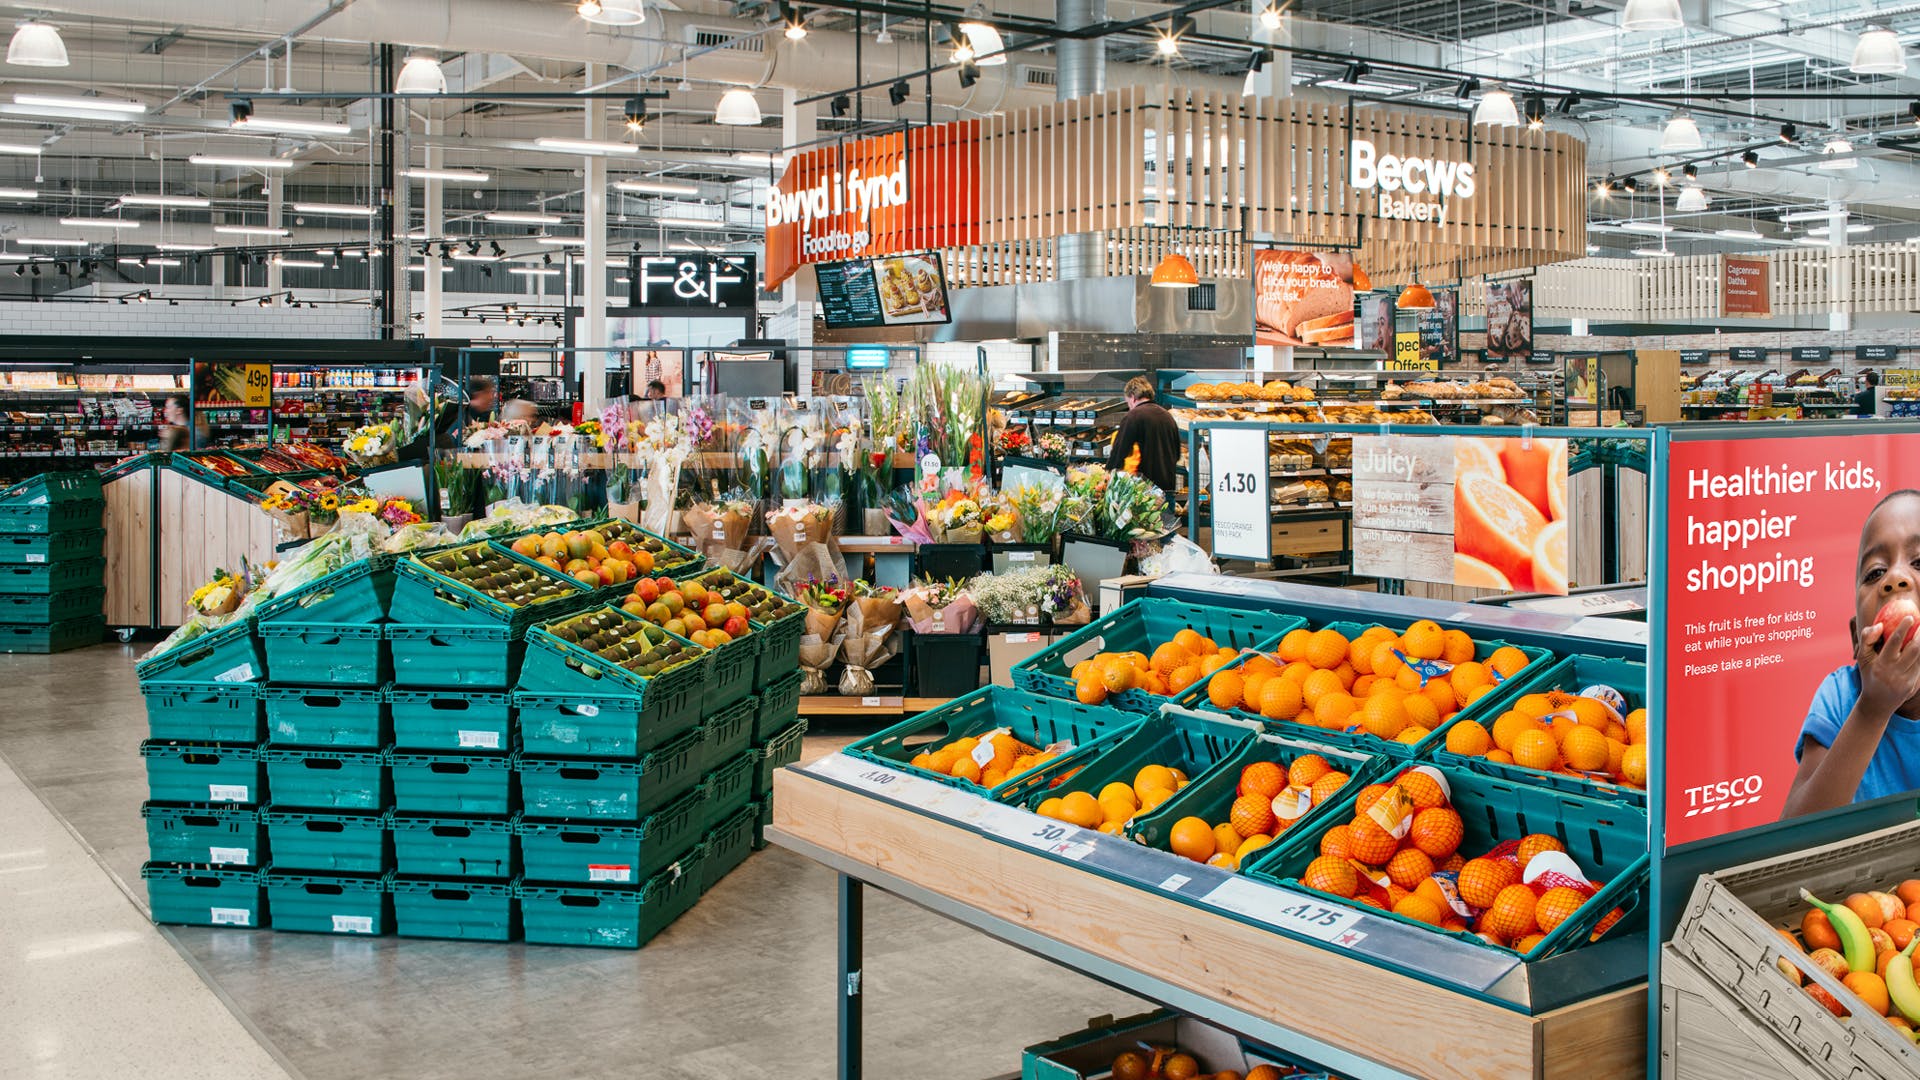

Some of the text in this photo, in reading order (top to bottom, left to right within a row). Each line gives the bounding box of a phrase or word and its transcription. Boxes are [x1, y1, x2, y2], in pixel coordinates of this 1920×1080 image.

[1351, 140, 1475, 198] Becws
[766, 160, 907, 232] Bwyd i fynd
[1379, 194, 1448, 228] Bakery
[803, 230, 870, 255] Food to go
[641, 257, 745, 303] F&F
[1291, 262, 1320, 275] happy
[1321, 264, 1332, 274] to
[1262, 275, 1285, 286] slice
[1285, 279, 1308, 290] your
[1393, 360, 1430, 370] Offers
[247, 369, 268, 391] 49p
[1361, 448, 1417, 481] Juicy
[1219, 472, 1256, 494] £1.30
[1688, 460, 1881, 500] Healthier kids,
[1404, 490, 1419, 502] the
[1361, 503, 1430, 518] sun to bring you
[1361, 517, 1433, 532] oranges bursting
[1361, 529, 1414, 543] with flavour.
[1688, 509, 1797, 551] happier
[1686, 552, 1815, 595] shopping
[1685, 609, 1816, 635] This fruit is free for kids to
[1684, 626, 1814, 652] eat while you're shopping.
[1684, 653, 1784, 676] Please take a piece.
[1684, 775, 1763, 807] TESCO
[1281, 904, 1343, 926] £1.75
